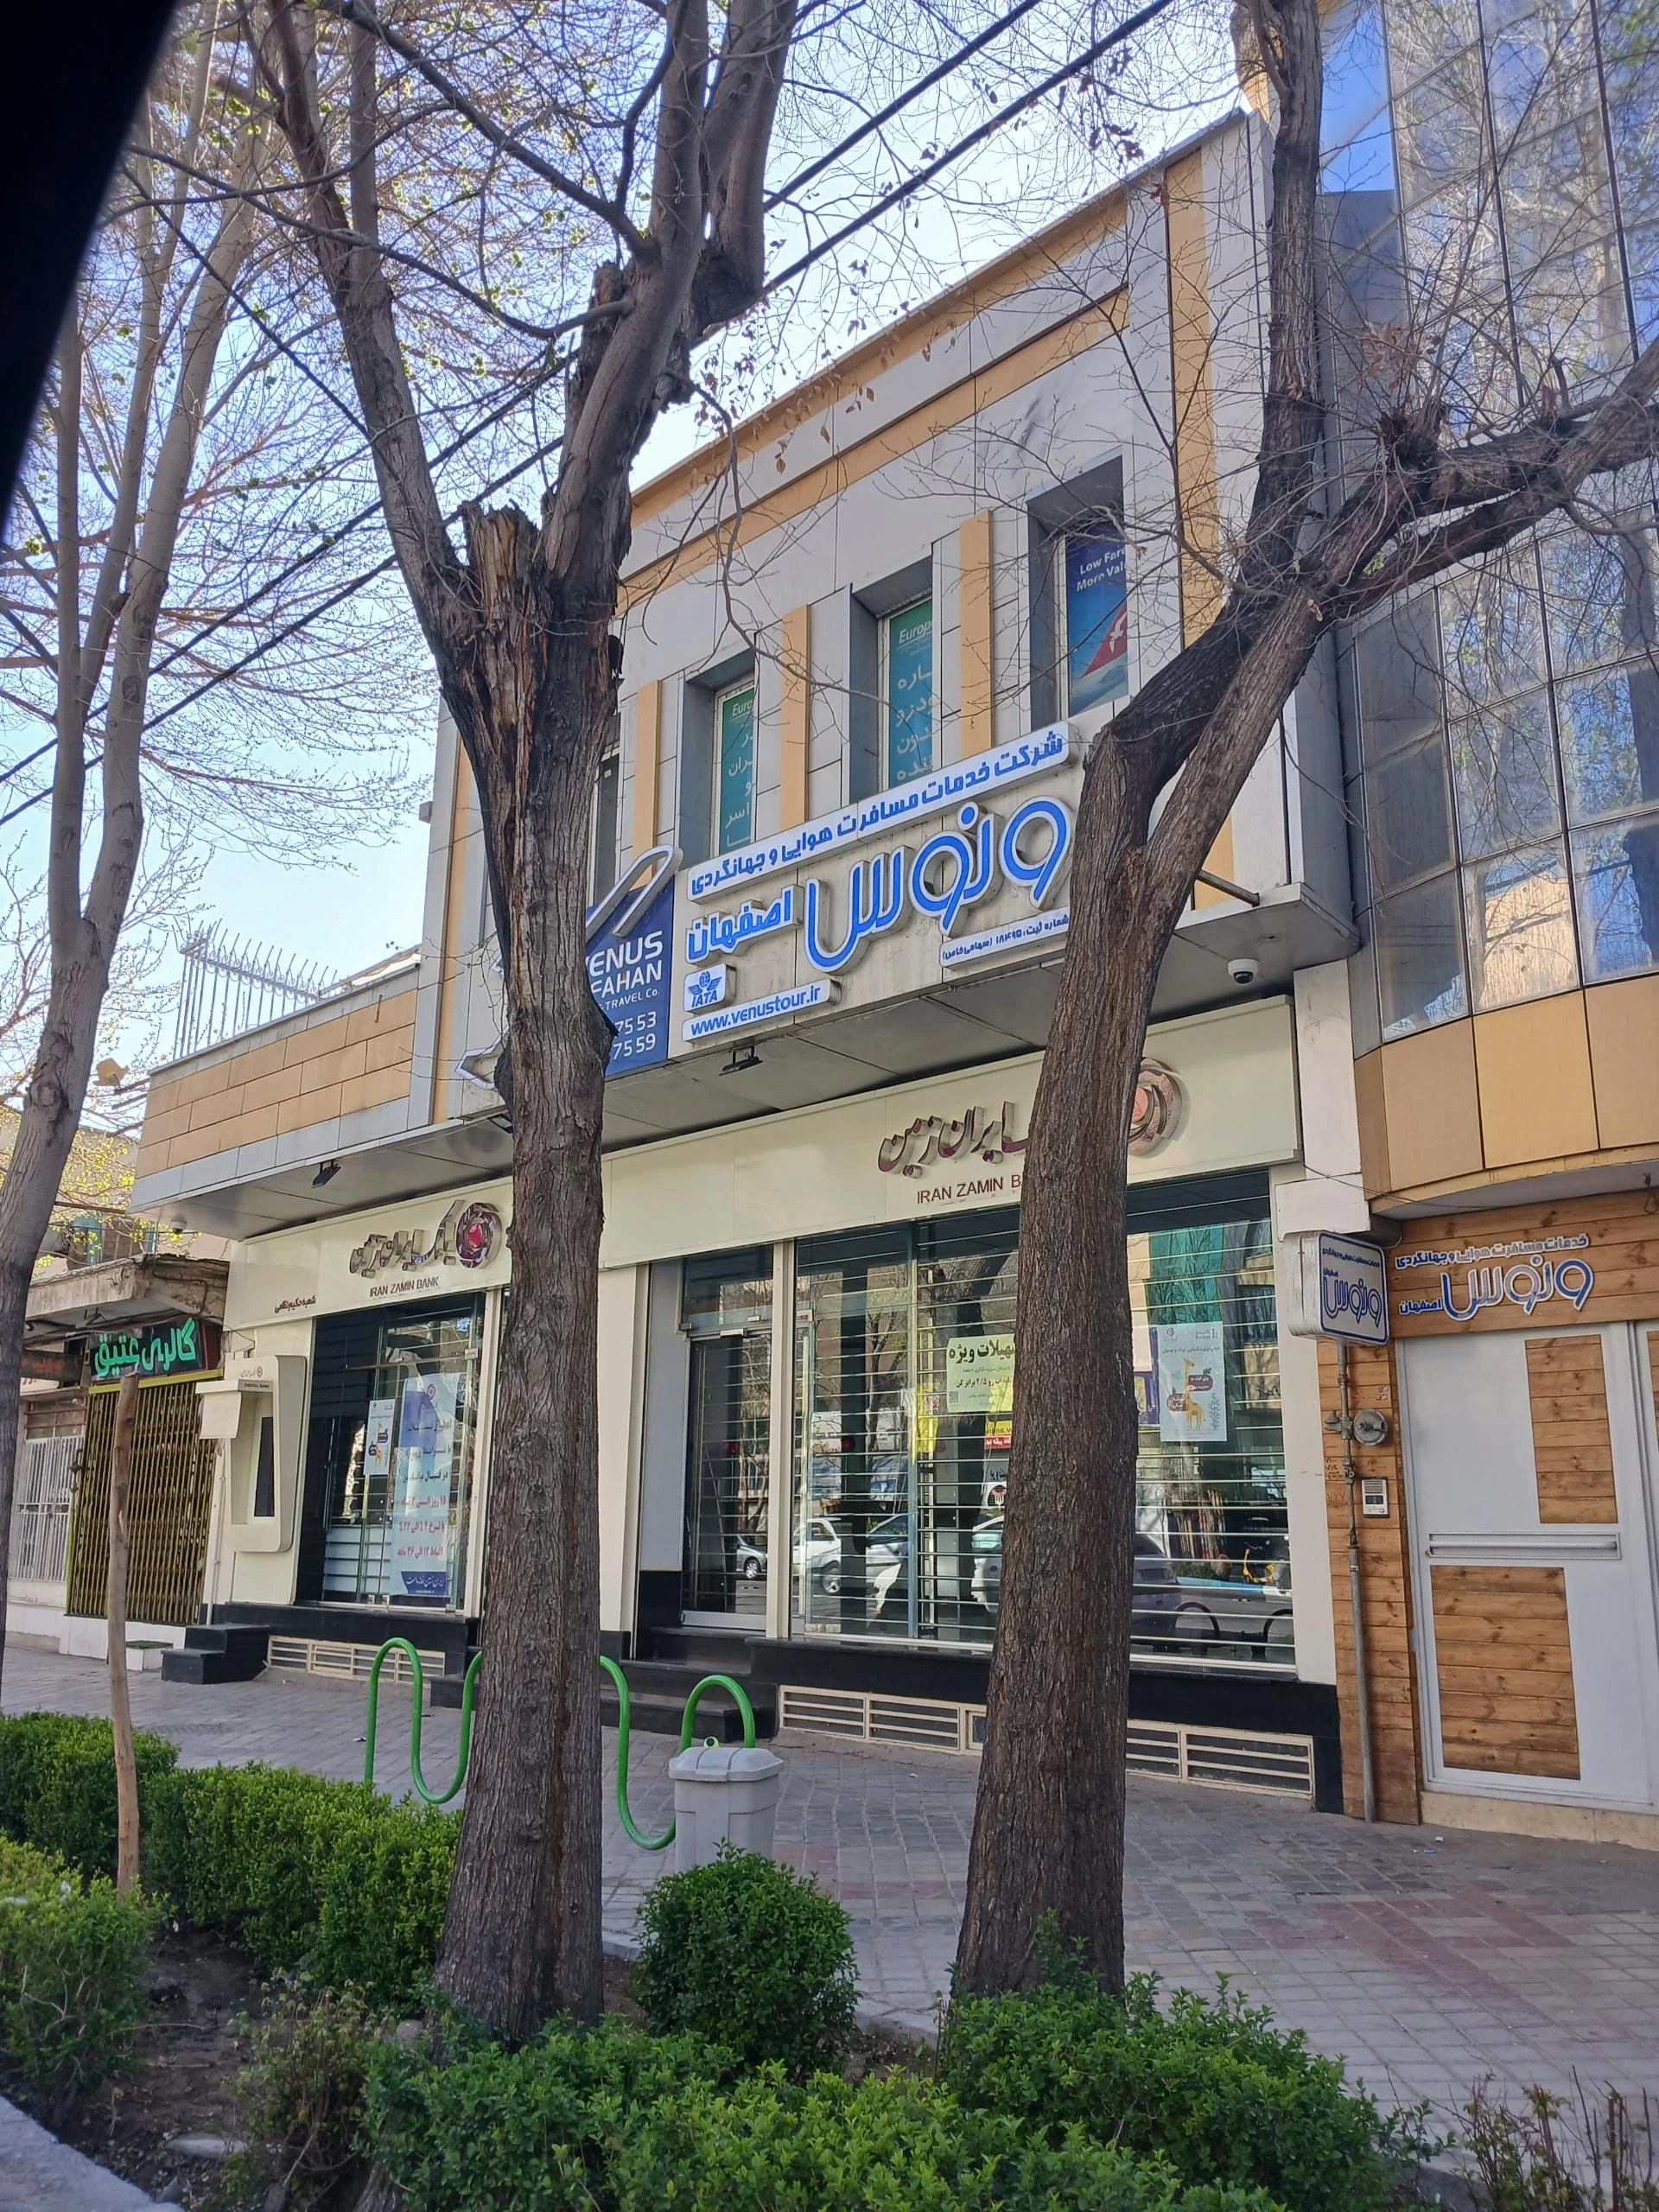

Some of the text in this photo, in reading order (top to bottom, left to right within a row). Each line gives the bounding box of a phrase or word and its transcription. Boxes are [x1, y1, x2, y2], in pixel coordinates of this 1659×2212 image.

[1080, 558, 1102, 575] Low
[1107, 561, 1123, 577] Val
[899, 620, 932, 644] Europ
[732, 699, 753, 717] Euro
[691, 730, 1063, 896] شرکت خدمات مسافرت هوایی و جهانگردی
[725, 803, 750, 829] اسر
[806, 797, 1072, 973] ونوس
[688, 885, 792, 963] اصفهان
[1044, 913, 1069, 931] شماره
[591, 960, 662, 1000] FAHAN
[606, 993, 643, 1011] TRAVEL
[690, 985, 821, 1035] www.venustour.ir
[692, 989, 718, 1007] IATA
[917, 1187, 952, 1205] IRAN
[957, 1177, 1003, 1198] ZAMIN
[1492, 1239, 1544, 1258] مسافرت
[1544, 1233, 1589, 1251] خدمات
[1395, 1251, 1449, 1269] جهانگردی
[370, 1275, 440, 1297] IRAN ZAMIN BANK
[1440, 1254, 1594, 1321] ونوس
[1323, 1276, 1382, 1328] ونوس
[1399, 1298, 1444, 1316] اصفهان
[94, 1316, 196, 1377] گالری عتیق
[949, 1339, 1014, 1363] هیلات ویژه
